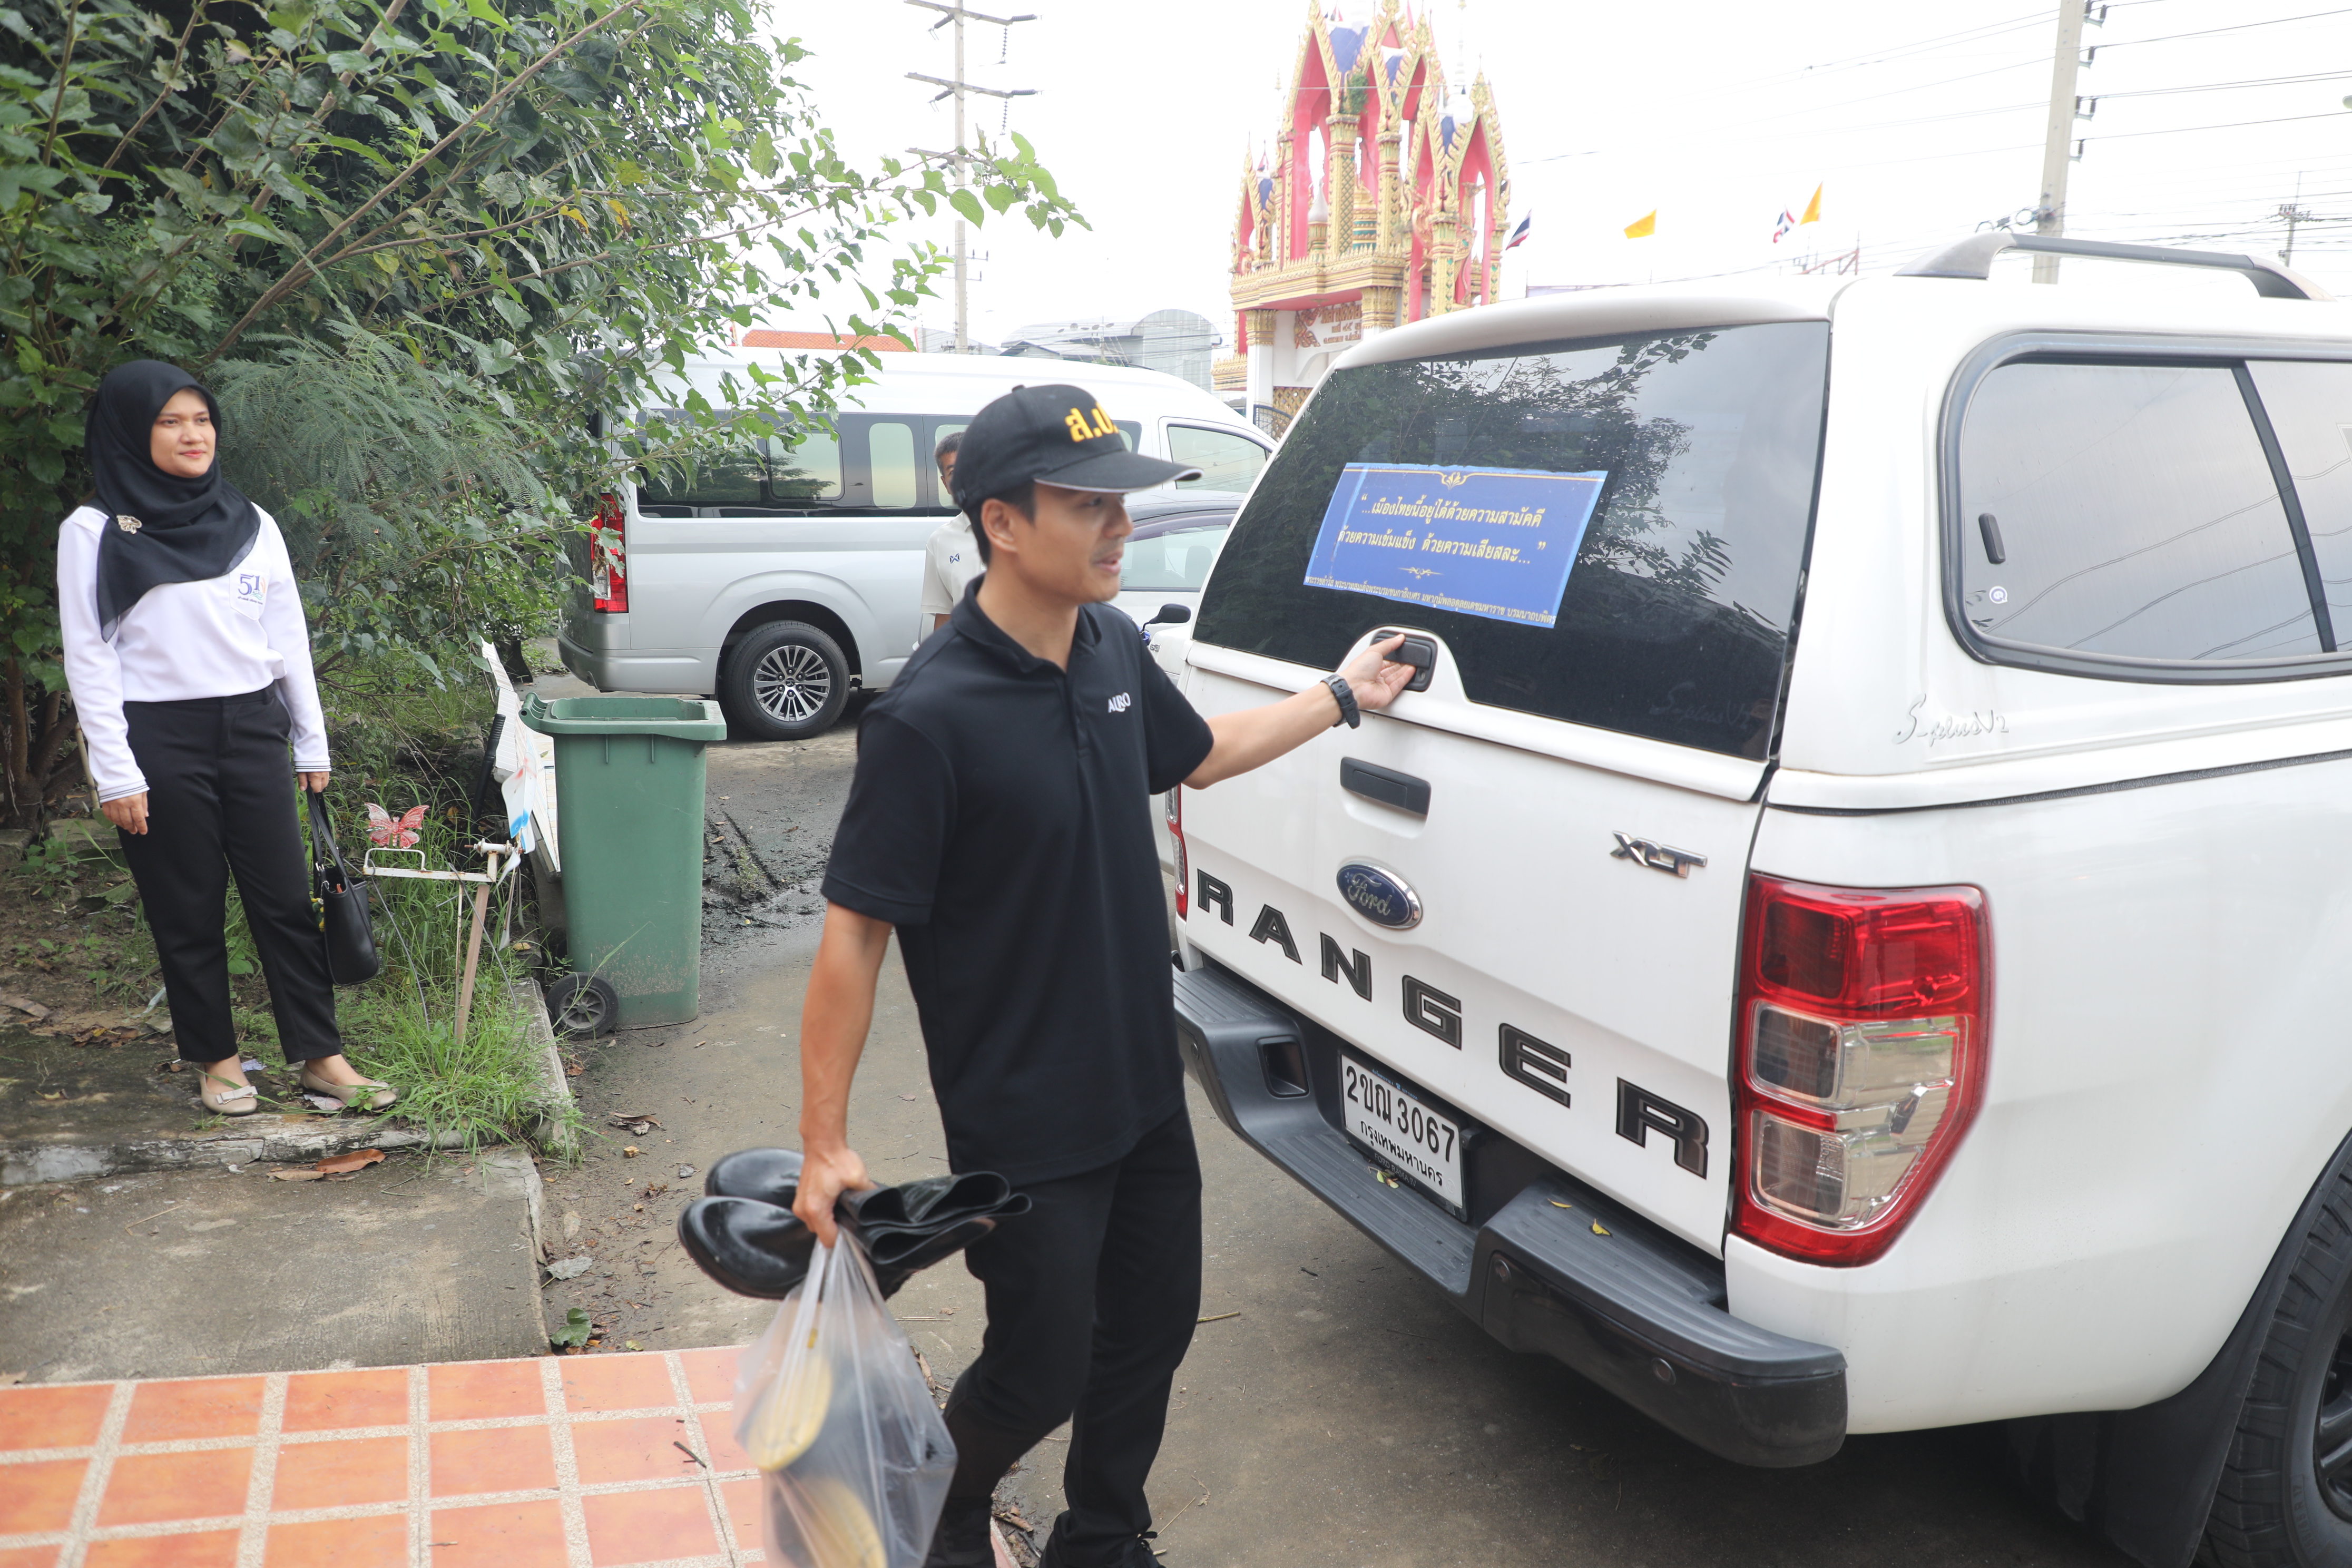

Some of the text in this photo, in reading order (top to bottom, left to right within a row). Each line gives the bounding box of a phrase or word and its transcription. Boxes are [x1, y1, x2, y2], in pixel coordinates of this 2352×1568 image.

[1338, 525, 1416, 550] ด้วยความเข้มแข็ง
[238, 573, 260, 595] 51
[1108, 692, 1131, 713] ALRO
[1610, 830, 1708, 879] XLT
[1347, 873, 1393, 916] Ford
[1197, 869, 1709, 1180] RANGER
[1397, 1097, 1455, 1163] 3067
[1360, 1121, 1443, 1186] กรุงเทพมหานคร
[1375, 1153, 1417, 1187] FORD RAMA IV
